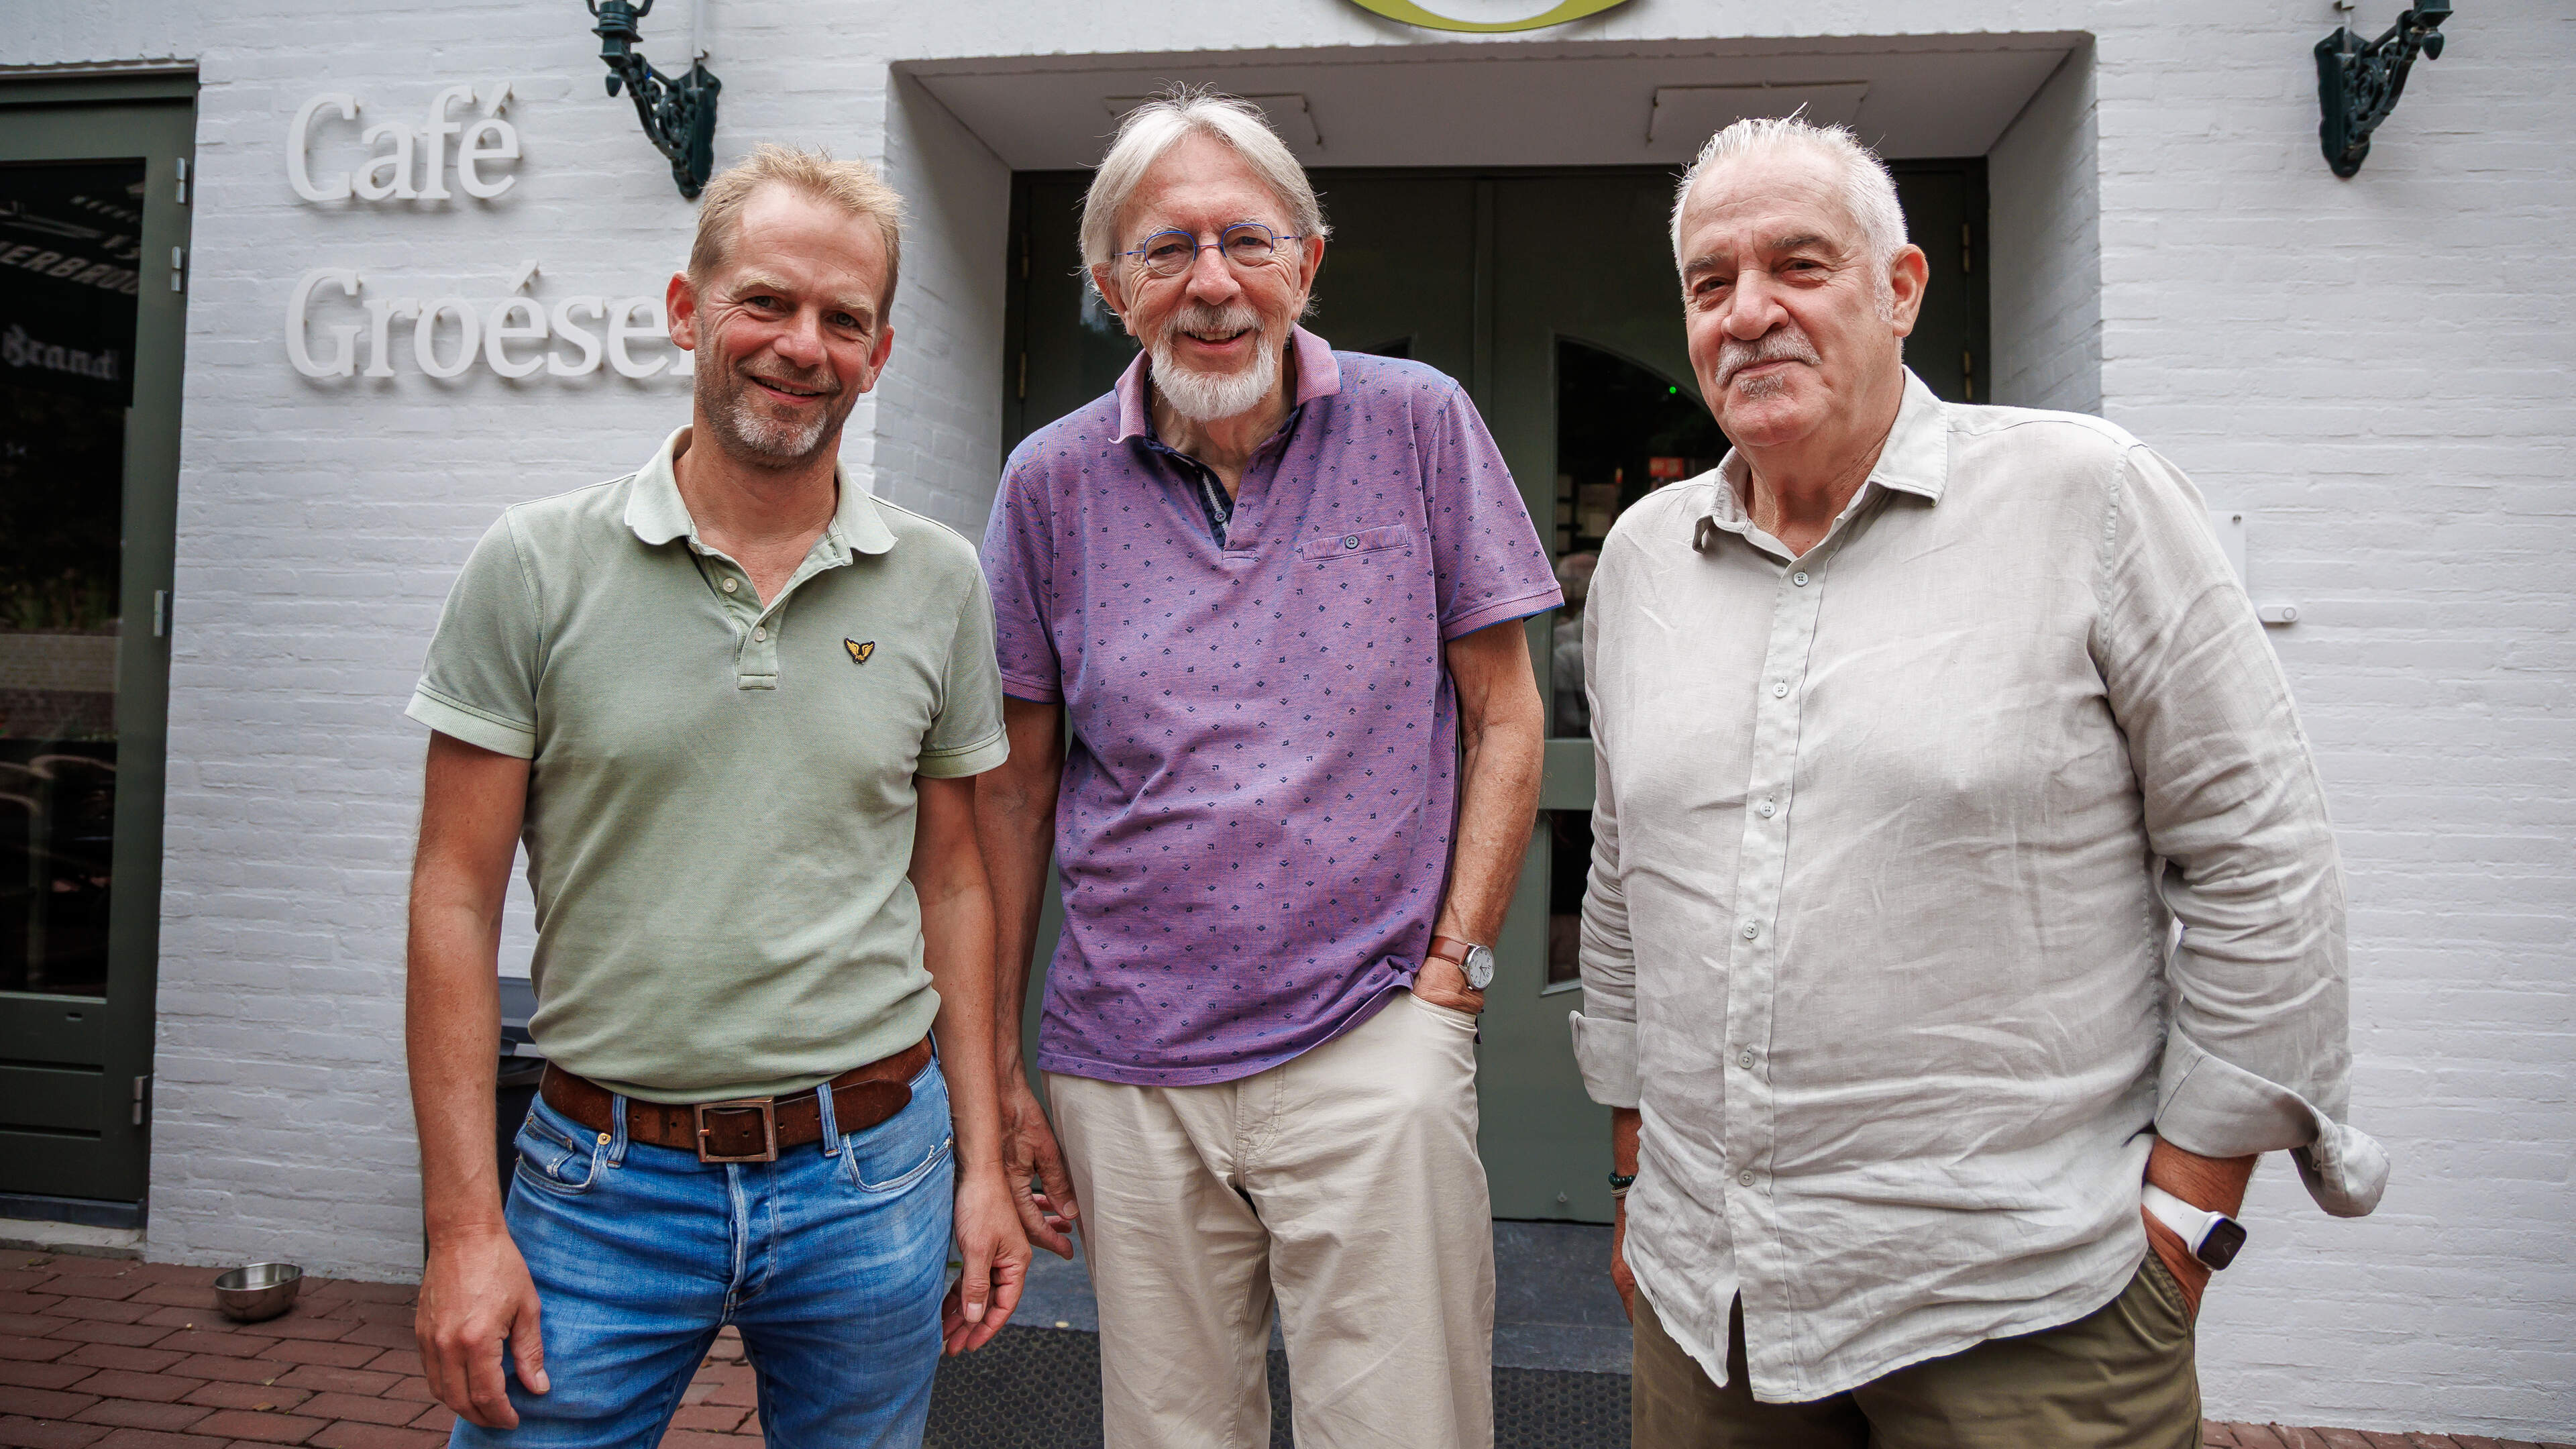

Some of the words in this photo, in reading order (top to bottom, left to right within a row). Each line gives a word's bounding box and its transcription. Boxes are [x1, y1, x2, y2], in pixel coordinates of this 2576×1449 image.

[286, 80, 521, 202] Café
[2, 323, 118, 380] Brand
[285, 259, 696, 380] Groése
